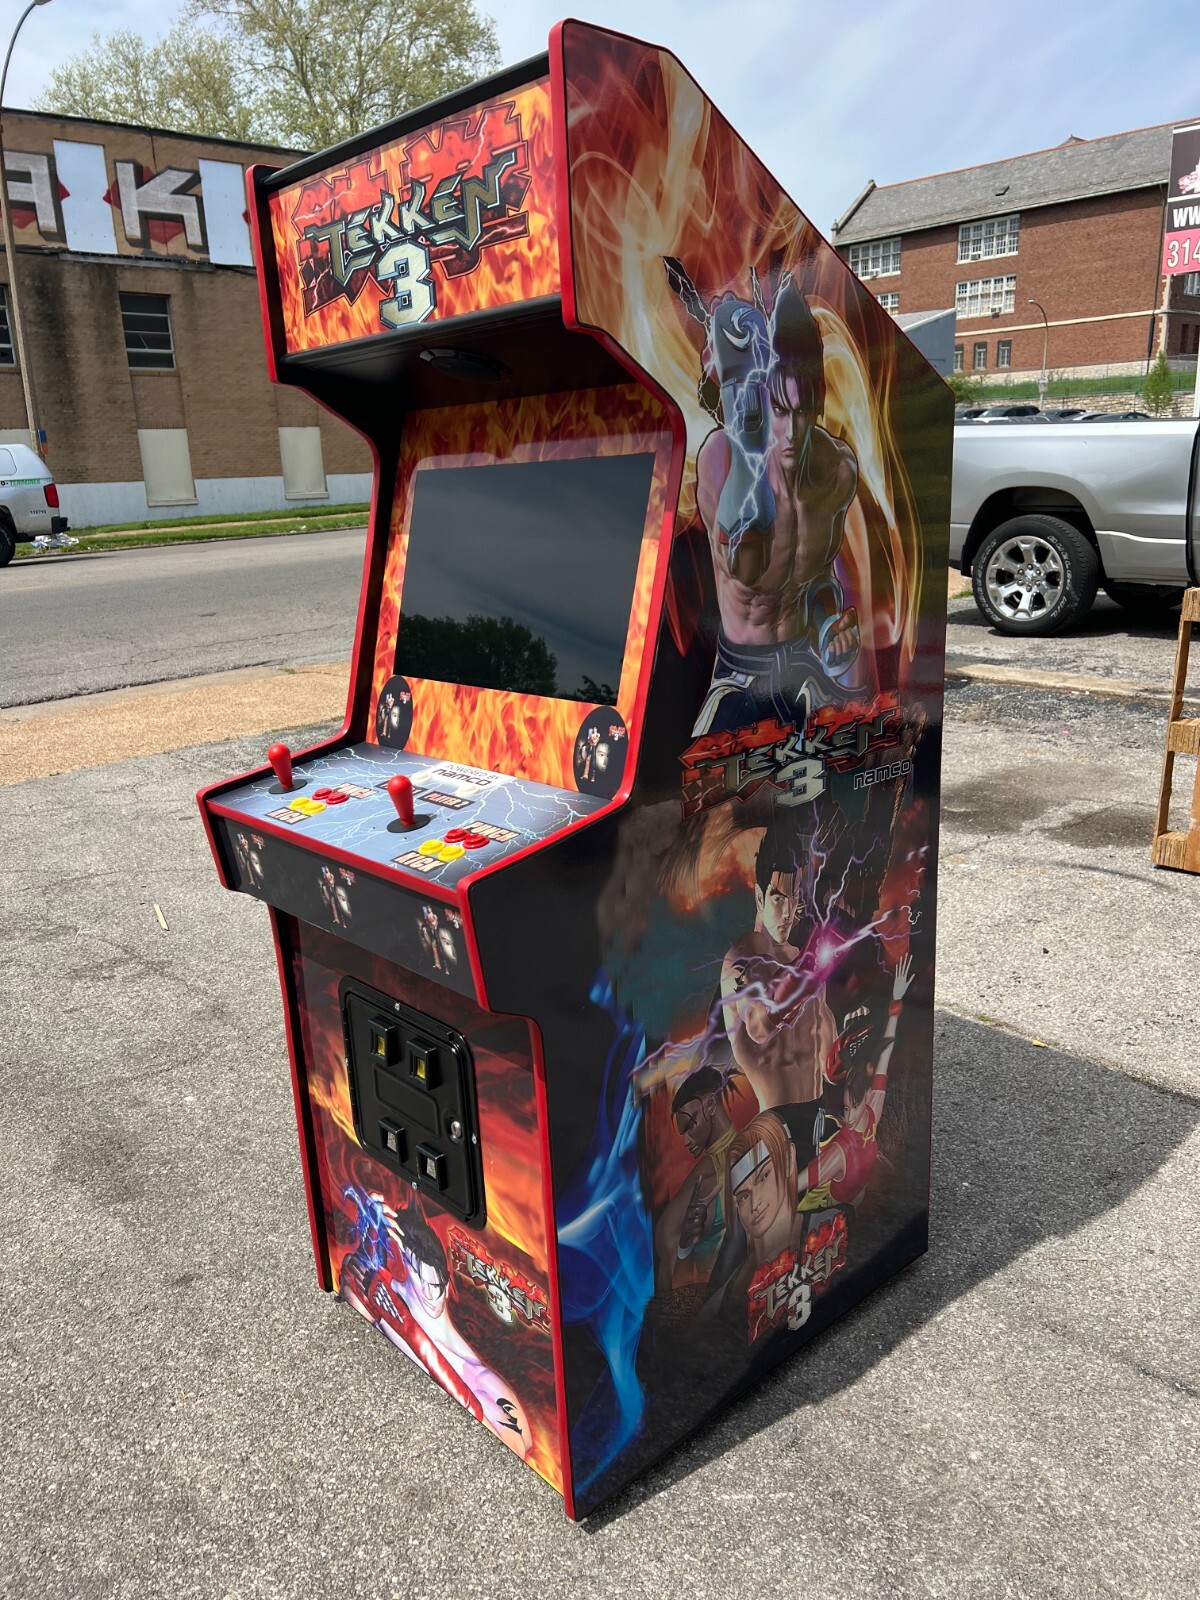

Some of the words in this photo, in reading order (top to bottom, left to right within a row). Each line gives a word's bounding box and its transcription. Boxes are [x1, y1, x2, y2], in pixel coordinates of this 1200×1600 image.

[303, 149, 516, 287] TEKKEN
[376, 238, 436, 330] 3
[447, 764, 488, 777] POWERED
[695, 709, 897, 793] TEKKEN
[853, 758, 912, 790] namco
[432, 768, 493, 787] namco
[775, 757, 827, 808] 3
[464, 820, 521, 842] PUNCH
[392, 851, 447, 873] KICK
[454, 1241, 547, 1320] TEKKEN
[754, 1232, 845, 1320] TEKKEN
[487, 1284, 514, 1324] 3
[787, 1283, 812, 1331] 3
